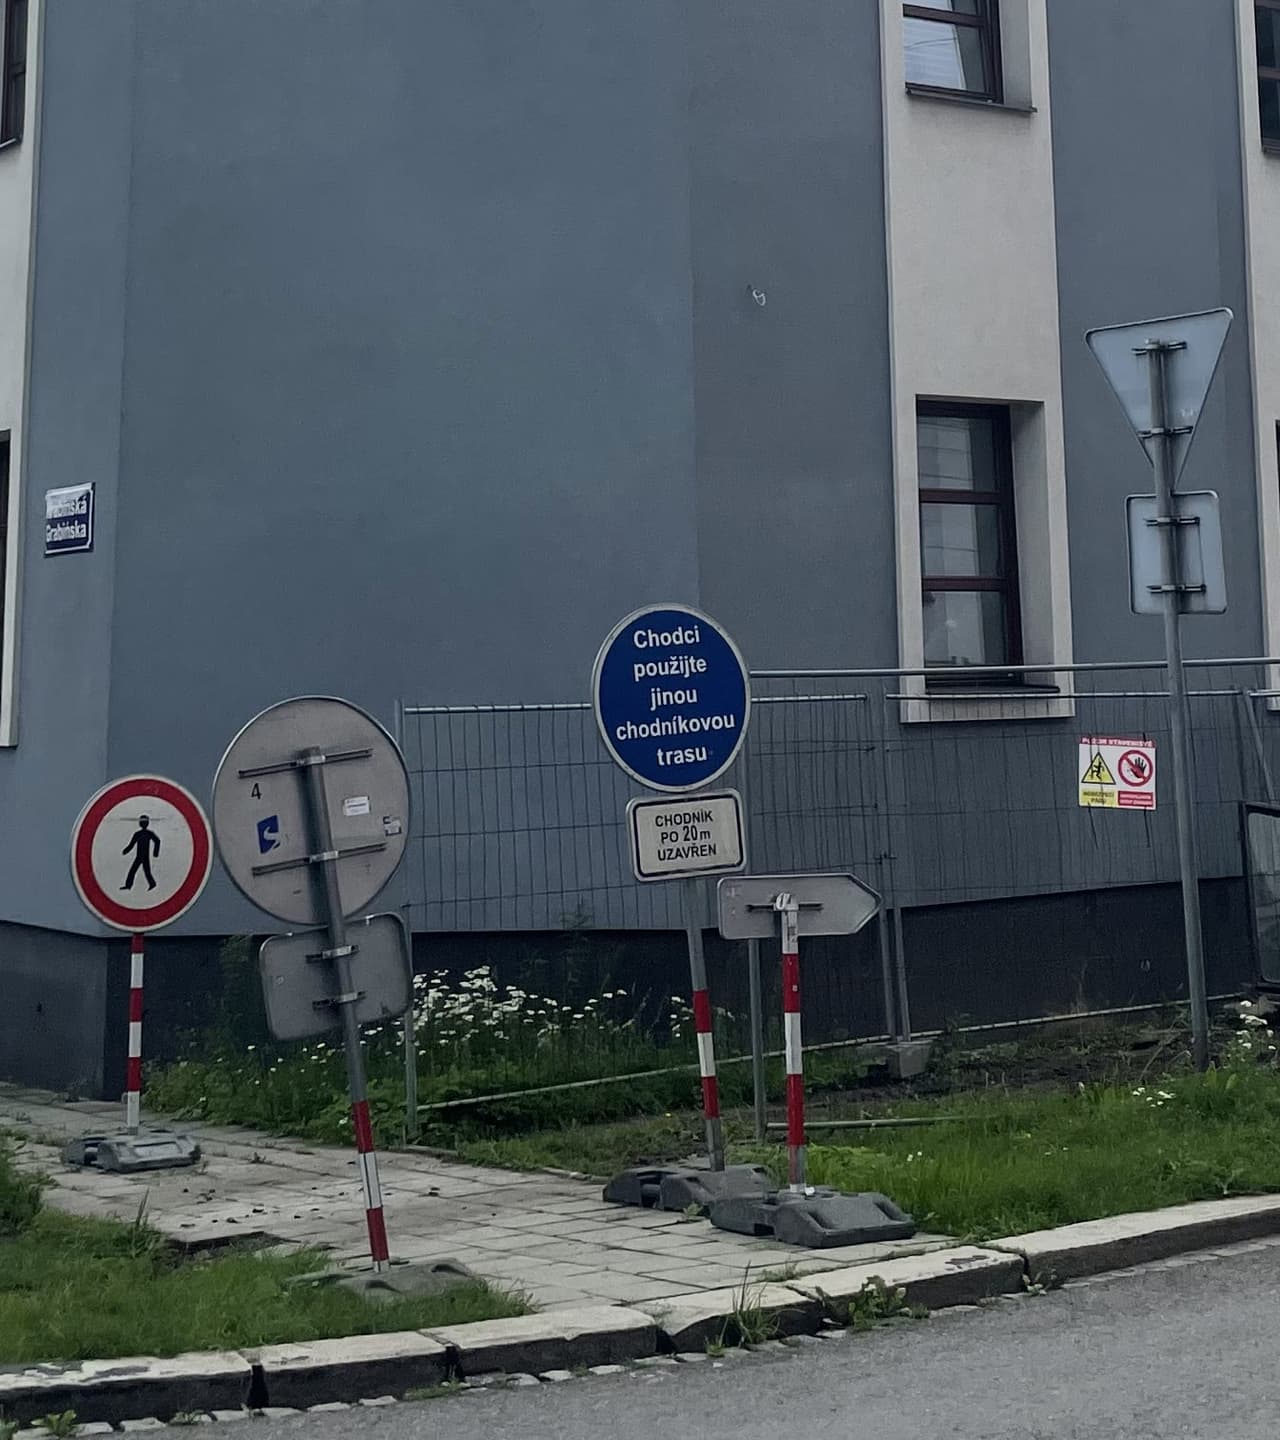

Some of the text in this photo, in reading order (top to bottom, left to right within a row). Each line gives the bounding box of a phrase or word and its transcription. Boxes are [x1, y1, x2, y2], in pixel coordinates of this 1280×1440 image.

[633, 625, 700, 649] Chodci
[633, 656, 707, 682] použijte
[650, 688, 698, 711] jinou
[616, 713, 736, 741] chodníkovou
[657, 746, 707, 766] trasu
[251, 783, 262, 800] 4
[655, 810, 714, 828] CHODNÍK
[660, 831, 679, 845] PO
[657, 842, 717, 862] UZAVŘEN
